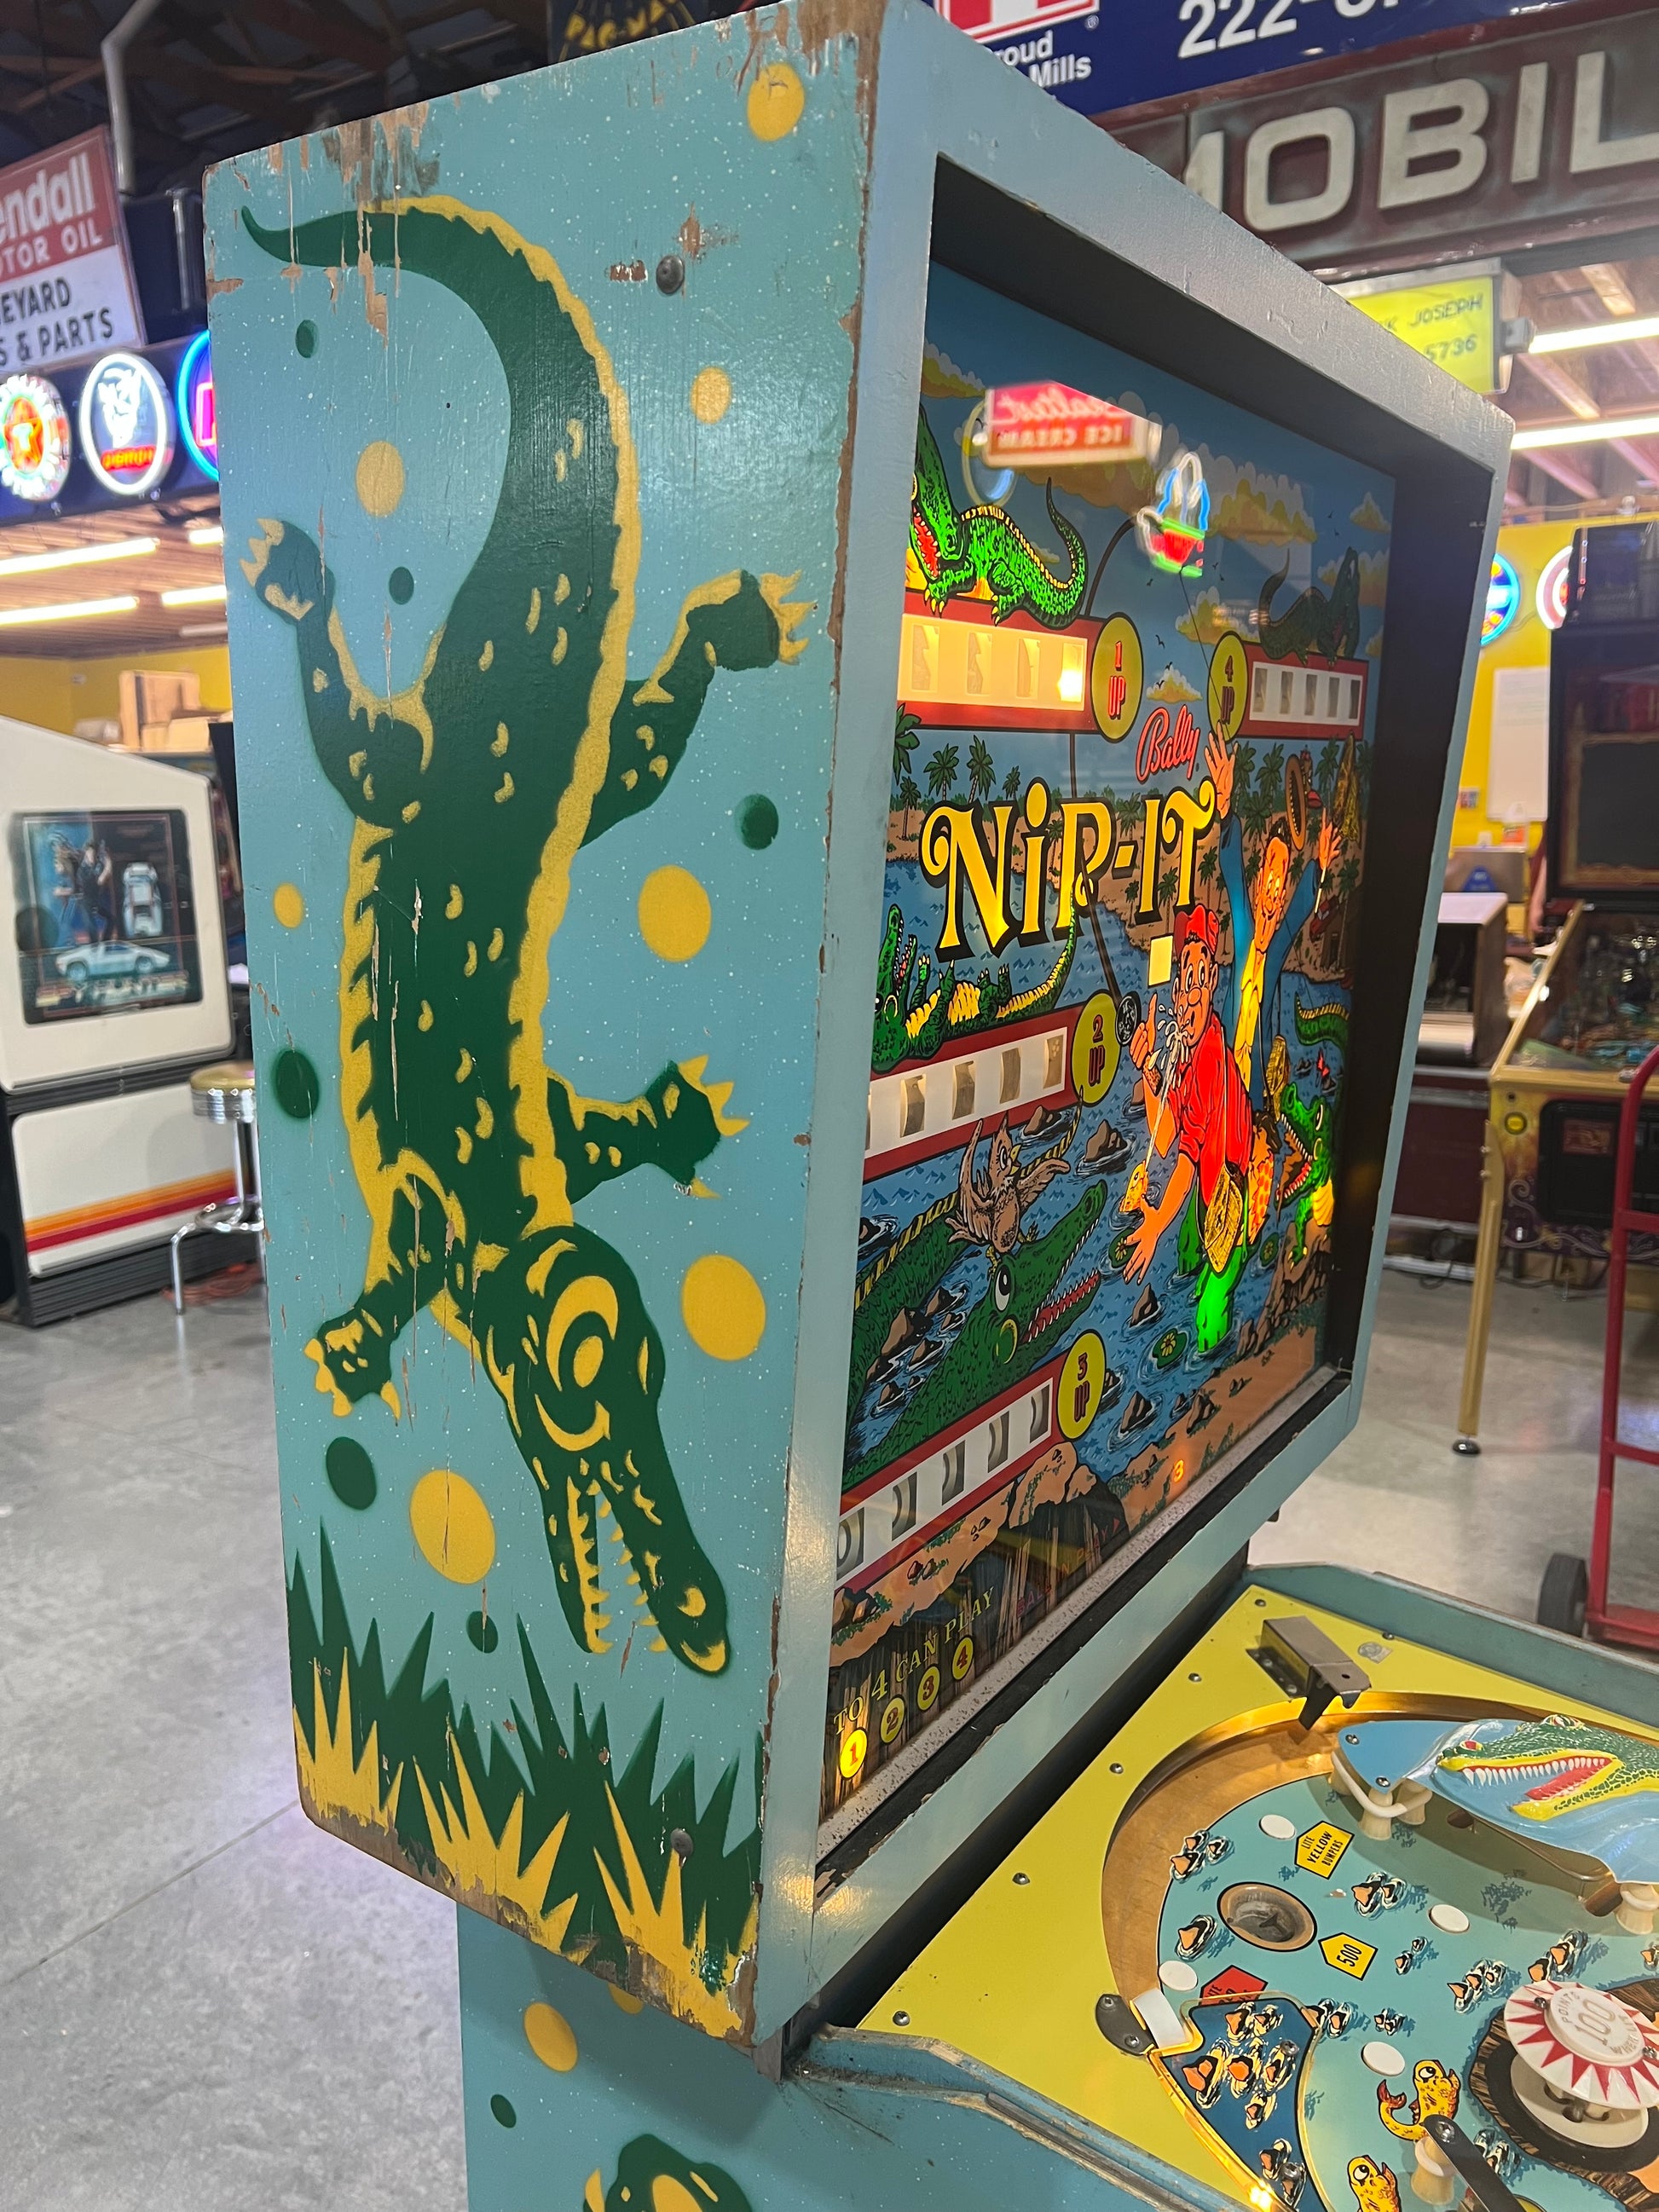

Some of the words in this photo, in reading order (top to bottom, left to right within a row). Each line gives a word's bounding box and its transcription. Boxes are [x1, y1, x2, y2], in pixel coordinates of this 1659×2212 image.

[1029, 54, 1092, 88] Mills
[0, 152, 95, 244] ndall
[0, 235, 50, 276] TOR
[61, 217, 103, 255] OIL
[38, 307, 113, 358] PARTS
[1108, 675, 1126, 720] UP
[1221, 685, 1235, 725] UP
[1135, 703, 1200, 786] Bally
[1088, 1044, 1106, 1087] UP
[1074, 1380, 1090, 1423] UP
[833, 1695, 864, 1736] TO
[871, 1669, 888, 1702] 4
[895, 1632, 939, 1684] CAN
[944, 1585, 995, 1644] PLAY
[1301, 1834, 1315, 1851] LITE
[1306, 1830, 1333, 1864] YELLOW
[1321, 1839, 1344, 1868] BUMPERS
[1336, 1943, 1363, 1967] 500
[1574, 1998, 1617, 2047] 100
